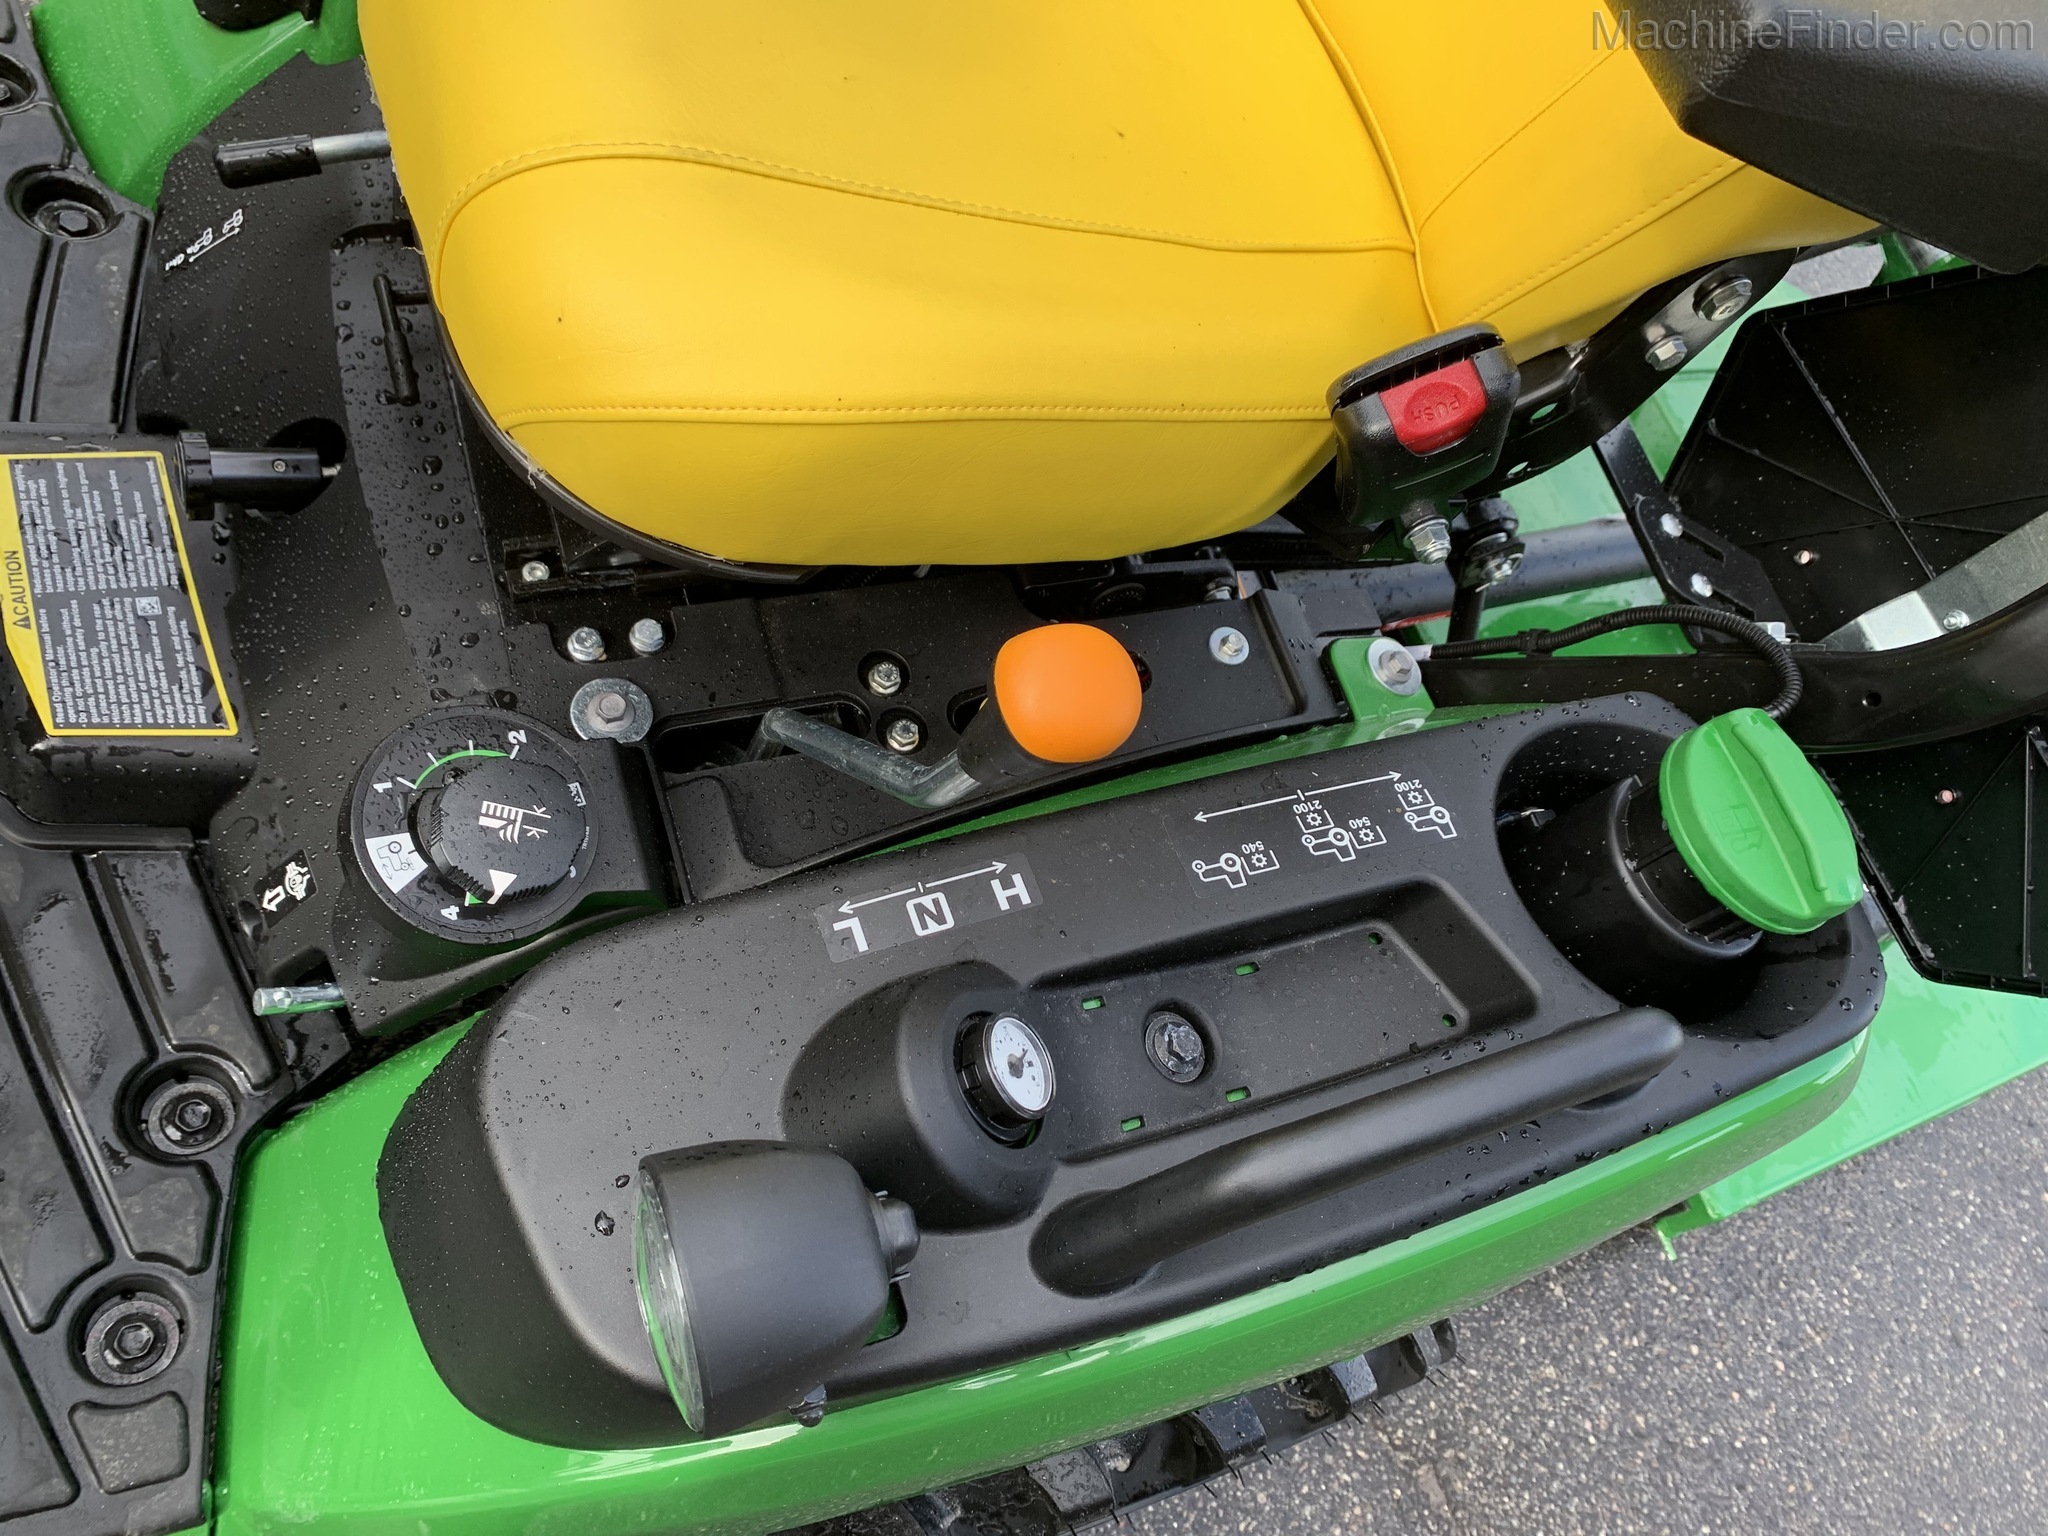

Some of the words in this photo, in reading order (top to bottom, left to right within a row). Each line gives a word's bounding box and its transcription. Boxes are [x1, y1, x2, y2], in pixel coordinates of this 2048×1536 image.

[1411, 393, 1460, 421] PUSH
[13, 464, 26, 490] applying
[54, 462, 68, 487] highway
[75, 462, 88, 484] ground
[107, 469, 118, 489] before
[26, 479, 38, 498] rough
[36, 479, 48, 496] steep
[61, 489, 68, 497] on
[41, 497, 48, 505] or
[91, 490, 102, 511] before
[111, 491, 123, 505] stop
[132, 491, 143, 512] tractor
[19, 500, 32, 523] turning
[29, 500, 41, 523] around
[41, 506, 55, 529] ground
[61, 499, 74, 517] lights
[23, 524, 34, 543] when
[75, 520, 86, 528] by
[34, 525, 49, 558] operating
[46, 531, 59, 552] rough
[87, 528, 98, 545] lower
[27, 544, 40, 565] speed
[51, 553, 59, 562] on
[101, 542, 112, 561] brake
[123, 551, 132, 559] all
[143, 545, 155, 557] key
[125, 561, 135, 570] for
[134, 555, 151, 586] servicing
[145, 558, 159, 586] Remove
[4, 550, 29, 616] CAUTION
[30, 567, 42, 592] Reduce
[41, 568, 53, 592] brakes
[52, 564, 64, 591] hazards
[76, 577, 86, 590] Use
[84, 567, 96, 589] unless
[96, 573, 109, 589] Stop
[107, 575, 117, 588] and
[68, 599, 81, 626] devices
[92, 603, 101, 617] rear
[111, 597, 123, 619] others
[121, 597, 136, 624] starting
[37, 608, 49, 631] before
[59, 608, 71, 634] without
[93, 619, 103, 630] the
[147, 620, 157, 633] and
[73, 628, 87, 650] safety
[104, 620, 118, 651] rearward
[126, 626, 139, 649] before
[170, 636, 181, 649] and
[41, 633, 54, 659] Manual
[64, 636, 77, 667] machine
[97, 641, 110, 656] only
[150, 635, 162, 658] tractor
[181, 639, 194, 662] driven
[77, 652, 88, 665] and
[100, 658, 112, 677] loads
[110, 653, 122, 673] avoid
[120, 645, 133, 675] children
[131, 650, 145, 680] machine
[154, 660, 165, 670] off
[46, 661, 63, 701] Operator's
[59, 672, 69, 685] this
[69, 668, 85, 696] operate
[80, 667, 93, 693] shields
[157, 672, 169, 692] riders
[188, 664, 201, 684] power
[93, 678, 104, 692] and
[104, 679, 117, 702] towed
[116, 684, 129, 702] plate
[125, 676, 138, 701] certain
[137, 682, 147, 690] of
[151, 689, 159, 697] or
[191, 686, 203, 703] from
[61, 687, 78, 722] operating
[74, 698, 85, 710] not
[96, 694, 110, 713] place
[139, 692, 151, 709] clear
[161, 694, 171, 702] all
[182, 694, 192, 702] all
[53, 703, 64, 722] Read
[77, 713, 87, 722] Do
[99, 715, 109, 723] in
[109, 703, 121, 723] Hitch
[119, 704, 131, 723] hitch
[130, 704, 142, 723] Make
[145, 711, 154, 723] are
[151, 699, 167, 723] engine
[163, 704, 177, 723] Keep
[184, 704, 198, 723] Keep
[197, 705, 209, 723] away
[1394, 779, 1422, 793] 2100
[1293, 800, 1322, 814] 2100
[1349, 816, 1371, 829] 540
[1242, 840, 1264, 854] 540
[990, 873, 1031, 911] H
[912, 897, 948, 931] N
[832, 917, 869, 952] L
